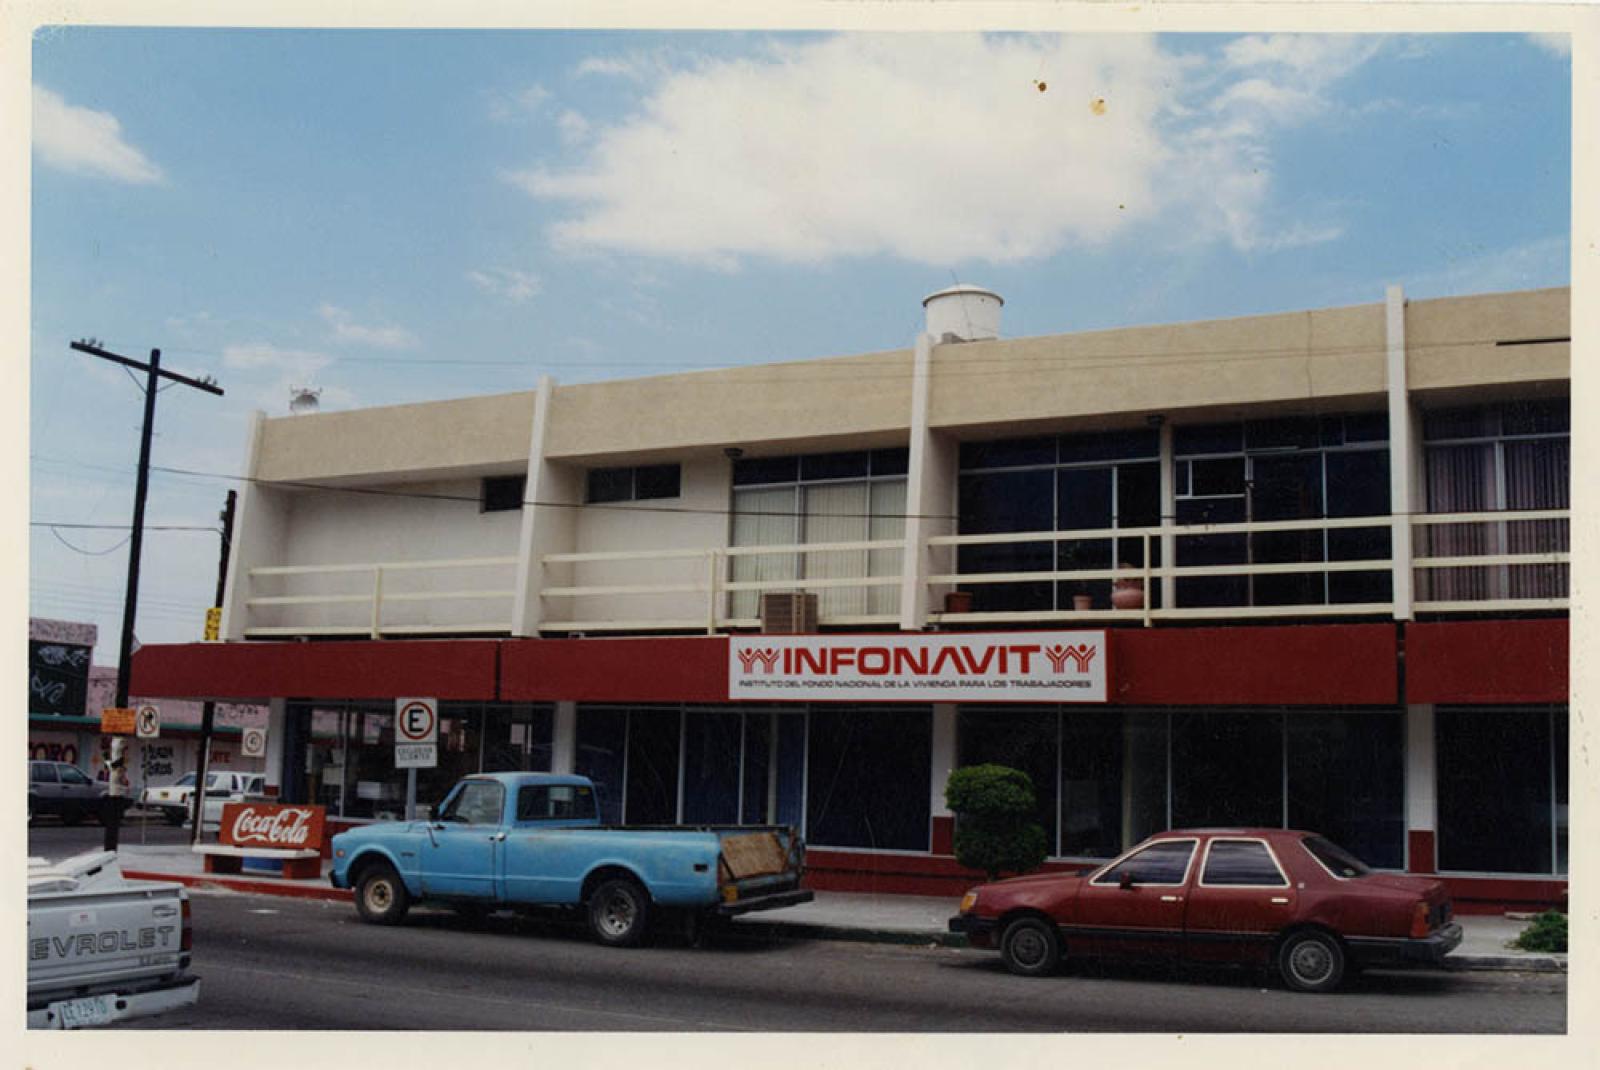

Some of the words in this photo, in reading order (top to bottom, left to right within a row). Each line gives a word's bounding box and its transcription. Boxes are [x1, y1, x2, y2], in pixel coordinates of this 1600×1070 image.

[783, 645, 1041, 676] INFONAVIT
[738, 680, 783, 688] INSTITUTO
[784, 680, 800, 688] DEL
[801, 680, 833, 688] FONDO
[834, 680, 881, 688] NACIONAL
[884, 680, 896, 688] DE
[898, 680, 911, 688] LA
[912, 680, 957, 688] VIVIENDA
[959, 680, 986, 688] PARA
[988, 680, 1007, 688] LOS
[1010, 680, 1091, 688] TRABAJADORES
[408, 709, 424, 731] E
